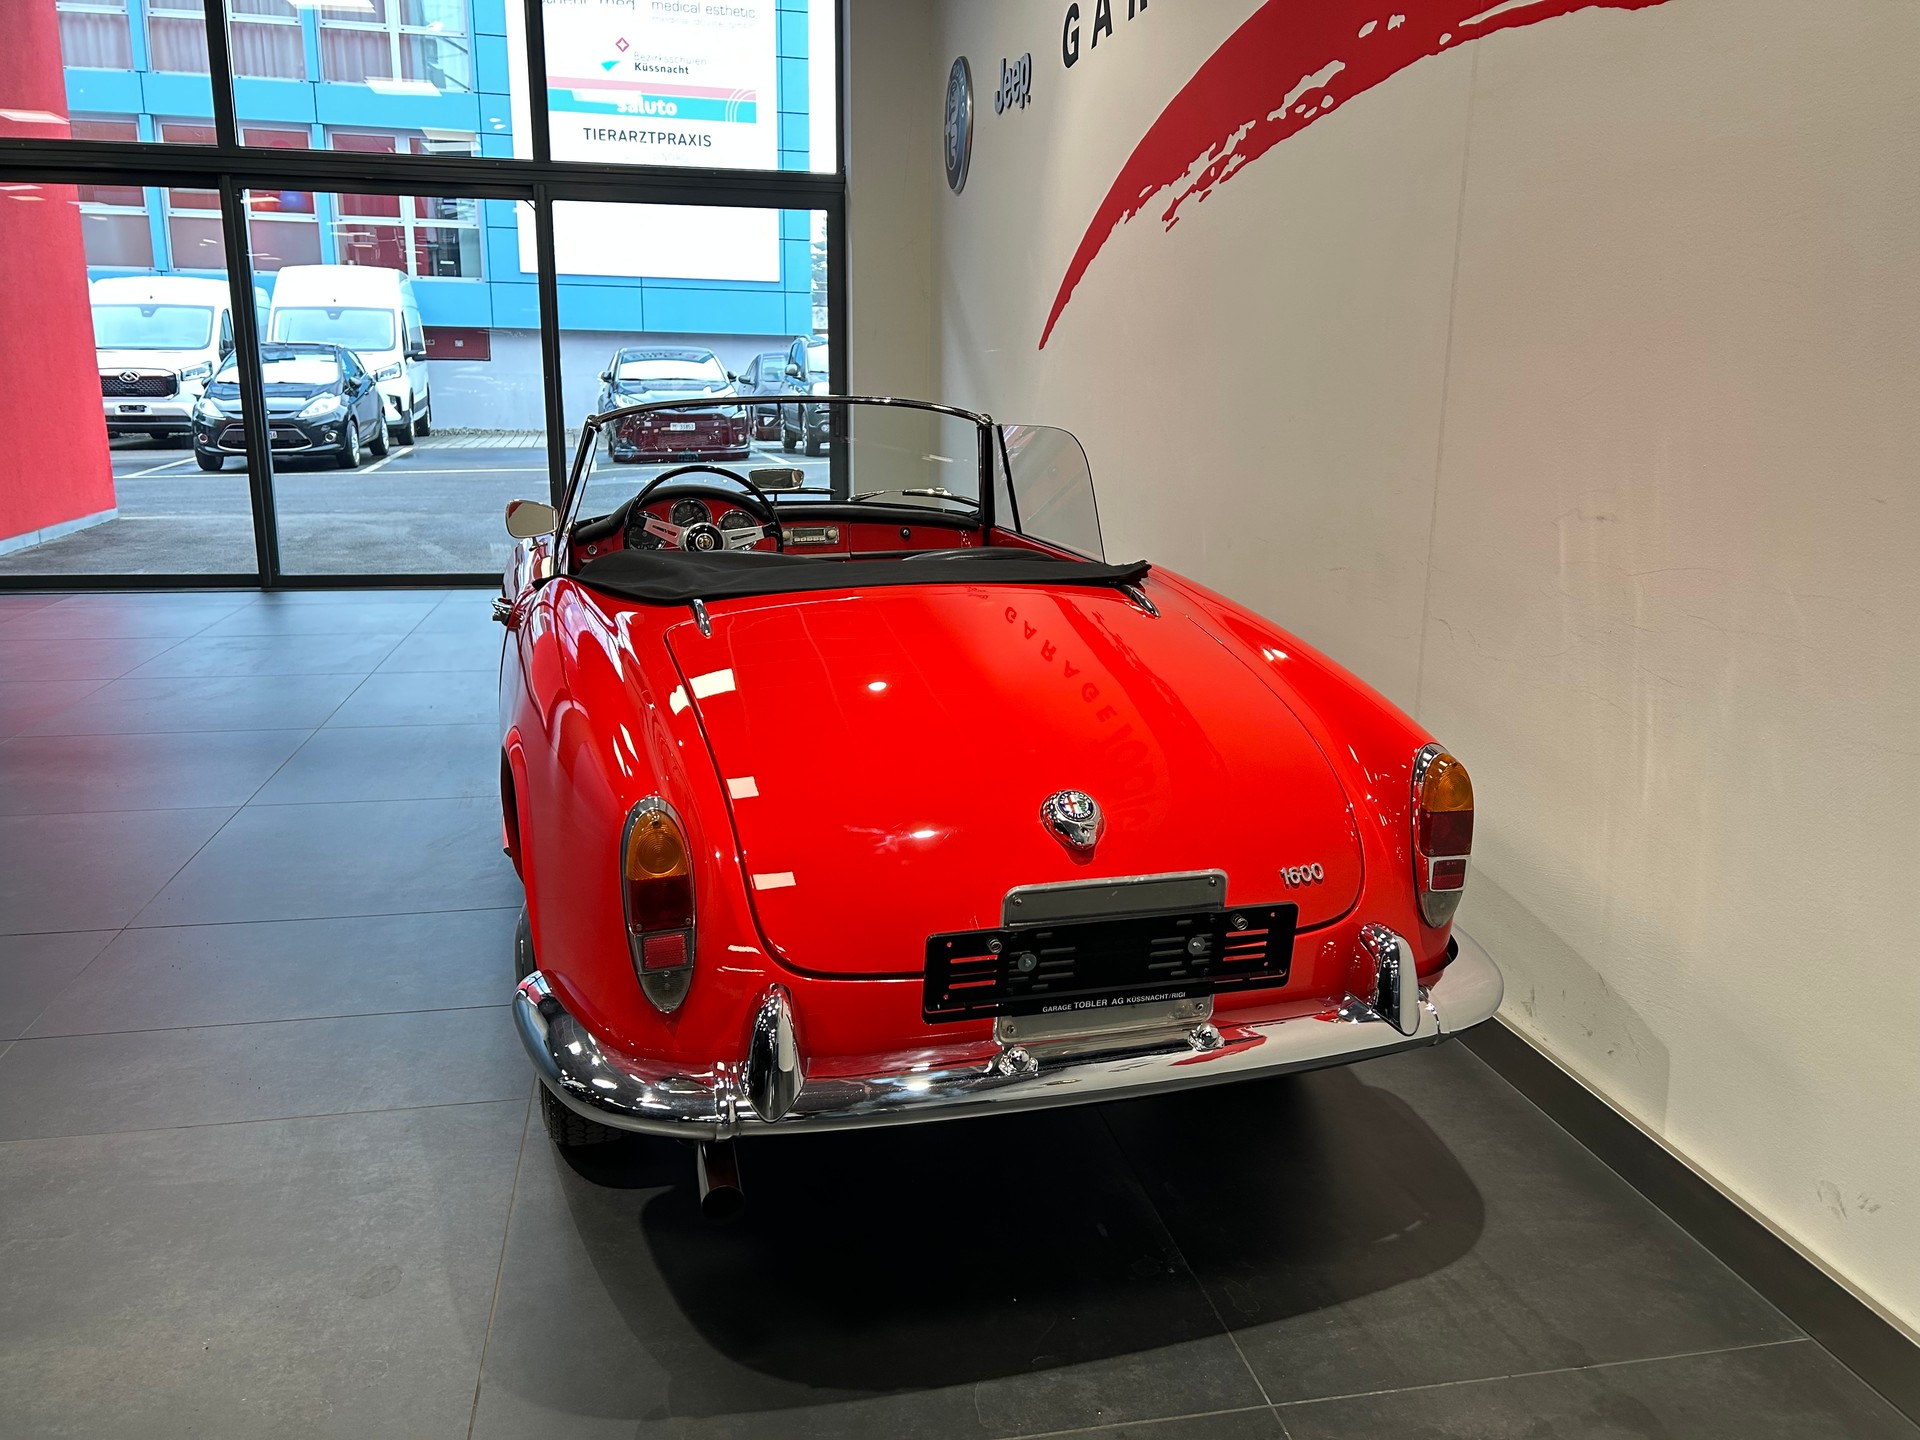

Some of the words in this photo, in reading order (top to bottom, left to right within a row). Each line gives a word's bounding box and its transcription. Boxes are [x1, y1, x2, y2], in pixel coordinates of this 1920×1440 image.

[651, 0, 701, 13] medical
[705, 4, 756, 18] esthetic
[634, 62, 689, 74] Küssnacht
[995, 53, 1031, 115] Jeep
[617, 94, 677, 115] saluto
[583, 128, 712, 147] TIERARZTPRAXIS
[1067, 810, 1091, 819] MILANO
[1280, 862, 1325, 885] 1600
[1042, 1003, 1072, 1013] GARAGE
[1073, 998, 1108, 1009] TOBLER
[1111, 997, 1124, 1006] AG
[1126, 991, 1186, 1003] KÜSSNACHT/RIGI
